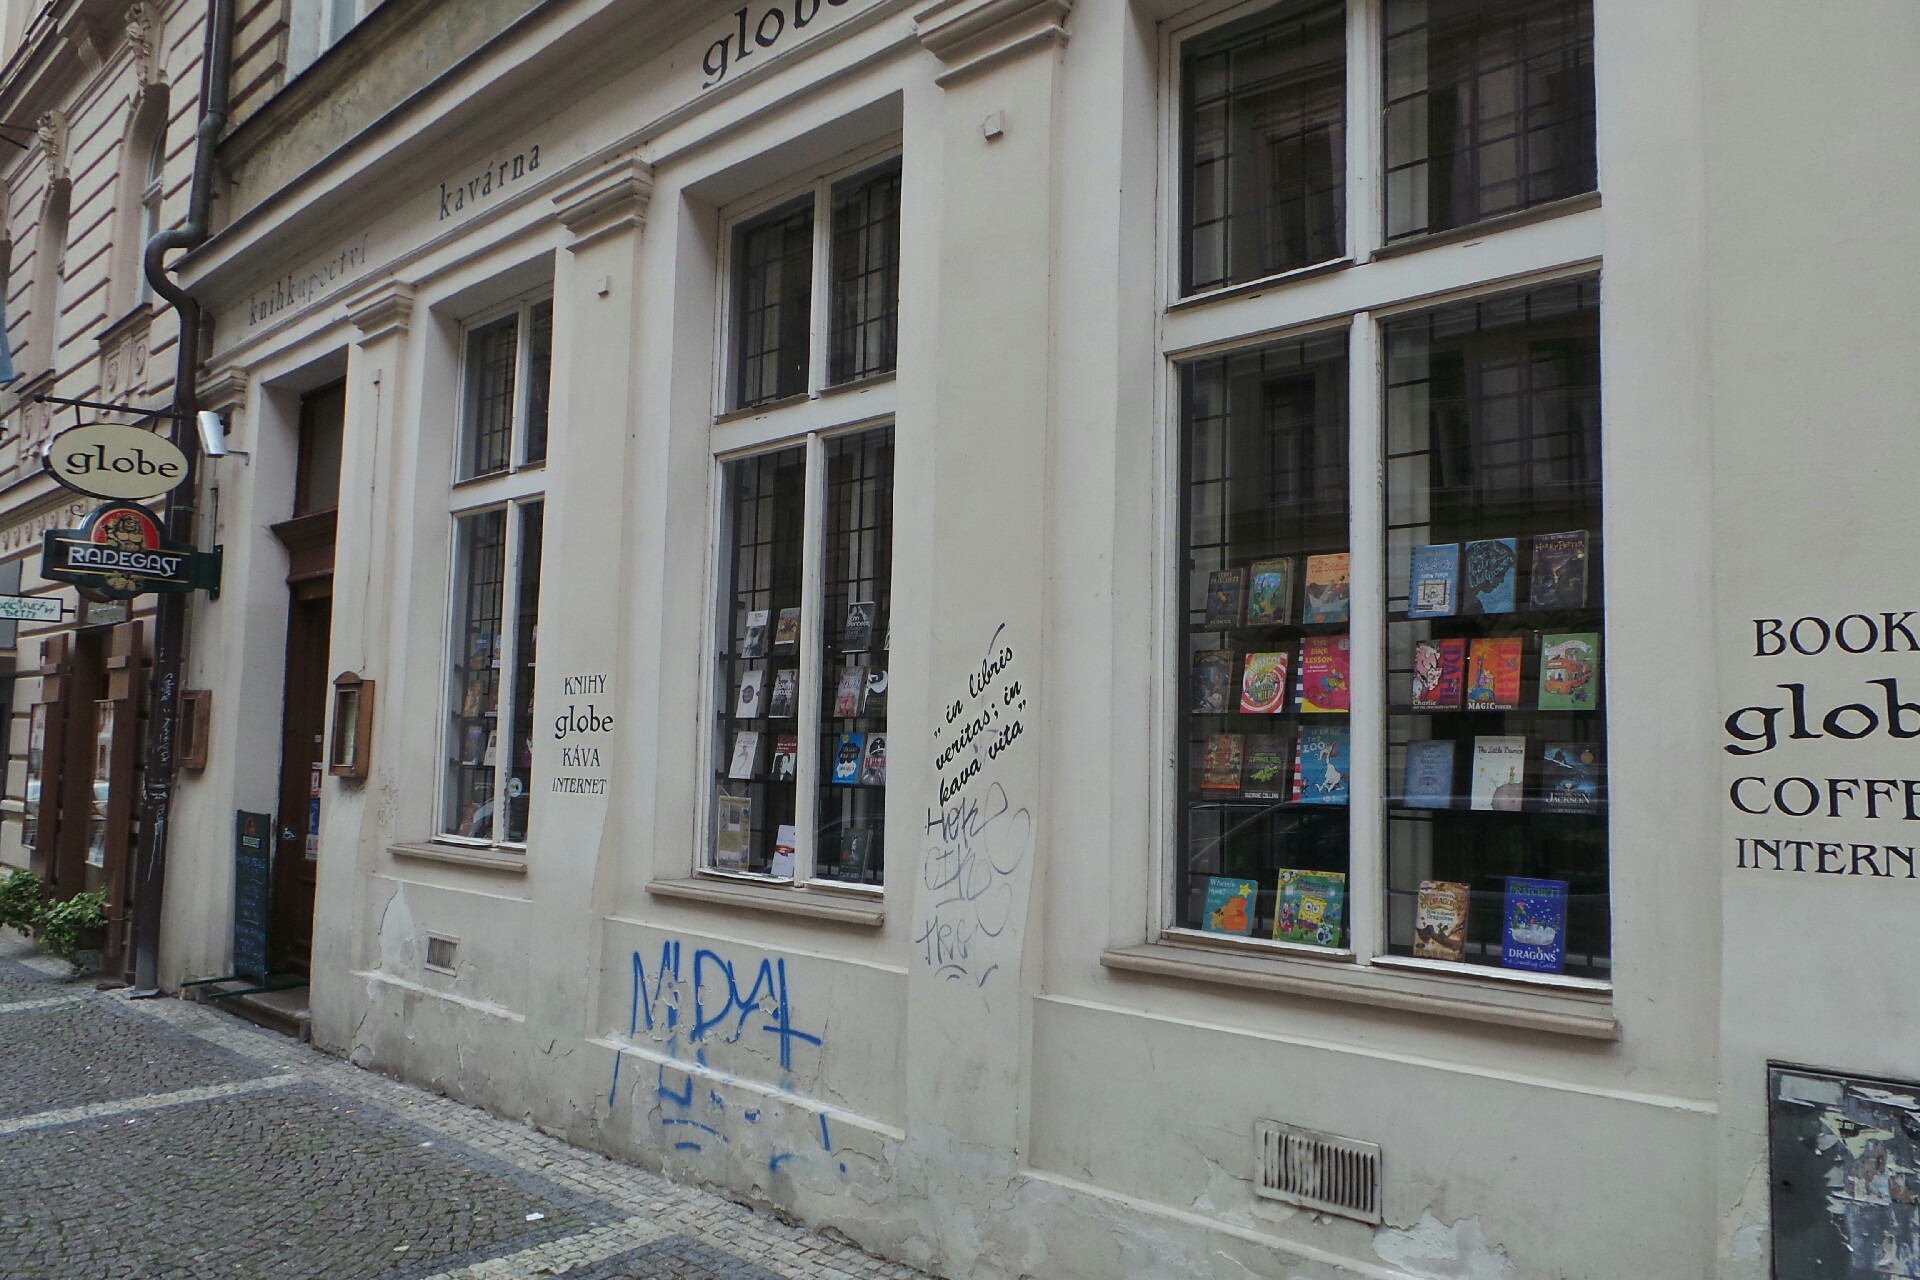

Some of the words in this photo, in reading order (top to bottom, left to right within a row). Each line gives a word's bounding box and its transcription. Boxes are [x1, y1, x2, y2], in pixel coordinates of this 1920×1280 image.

[702, 0, 848, 90] glob
[439, 144, 540, 221] kavárna
[65, 444, 179, 478] globe
[68, 546, 182, 577] RADEGAST
[1752, 611, 1920, 657] BOOK
[969, 647, 1013, 699] libris
[1305, 656, 1333, 664] LESSON
[564, 674, 607, 695] KNIHY
[554, 704, 614, 740] globe
[1468, 702, 1495, 710] MAGIC
[1723, 678, 1920, 756] glob
[936, 703, 999, 771] veritas;
[1003, 681, 1022, 706] in
[562, 743, 601, 767] KÁVA
[1303, 741, 1326, 754] ZOO
[552, 777, 607, 795] INTERNET
[940, 758, 982, 808] kava
[1545, 792, 1591, 804] JACKSON
[1735, 838, 1919, 879] INTERN
[1210, 877, 1236, 888] Where's
[1509, 948, 1557, 963] DRAGONS
